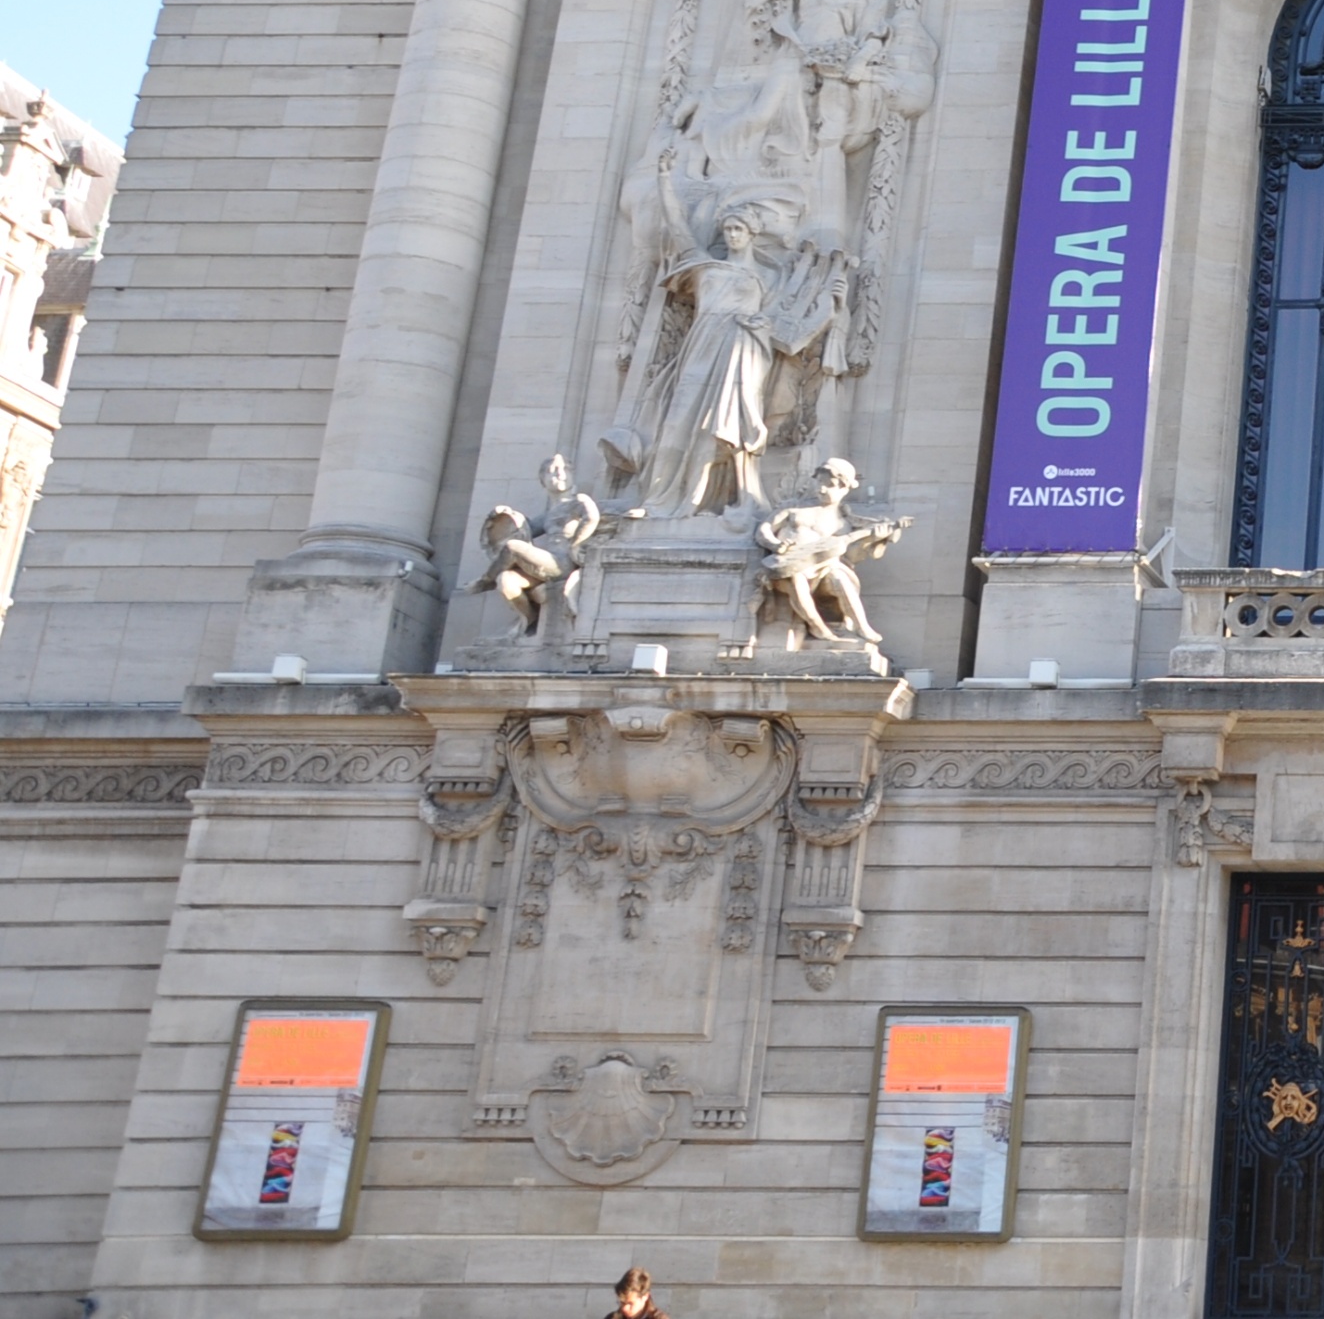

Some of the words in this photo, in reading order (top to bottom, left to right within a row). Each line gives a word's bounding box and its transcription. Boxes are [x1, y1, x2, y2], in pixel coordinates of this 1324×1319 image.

[1060, 130, 1137, 202] DE
[1036, 224, 1128, 437] OPERA
[1008, 487, 1126, 507] FANTASTIC
